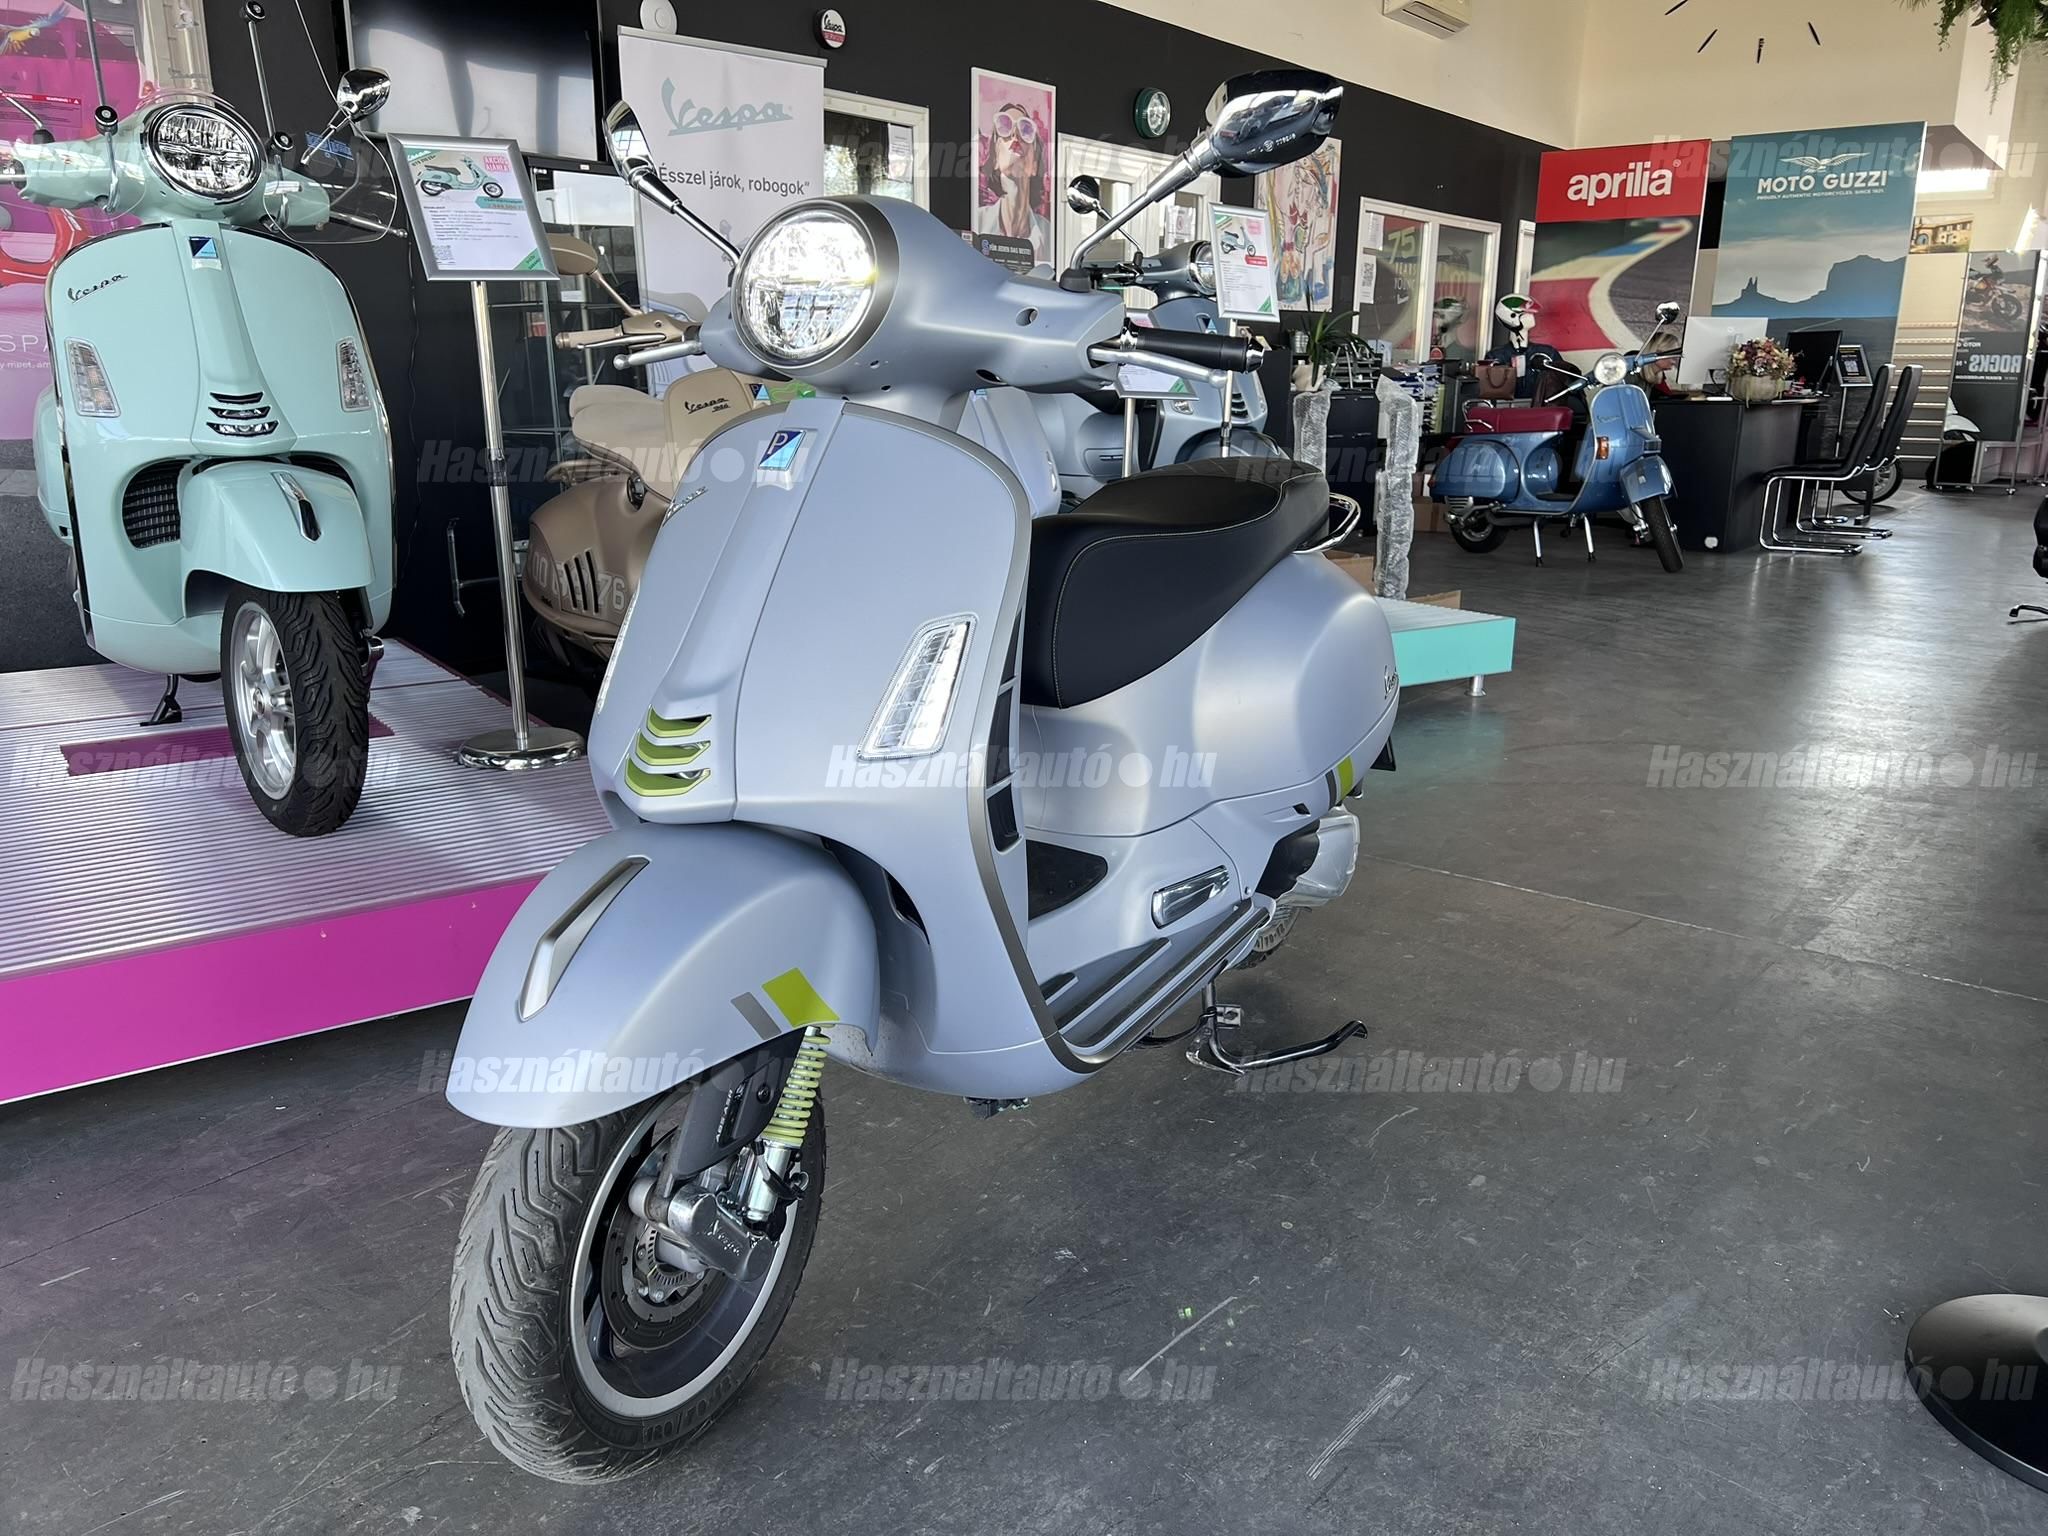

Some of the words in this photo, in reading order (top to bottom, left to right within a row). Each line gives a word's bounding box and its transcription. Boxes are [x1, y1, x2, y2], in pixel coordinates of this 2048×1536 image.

[661, 77, 793, 136] Vespa
[658, 163, 706, 185] Ésszel
[709, 171, 745, 192] járok,
[1567, 160, 1673, 206] aprilia
[1757, 175, 1816, 194] MOTO
[1822, 170, 1888, 190] GUZZI
[1388, 226, 1415, 264] 75
[68, 273, 128, 303] Vespa
[685, 398, 729, 414] Vespa
